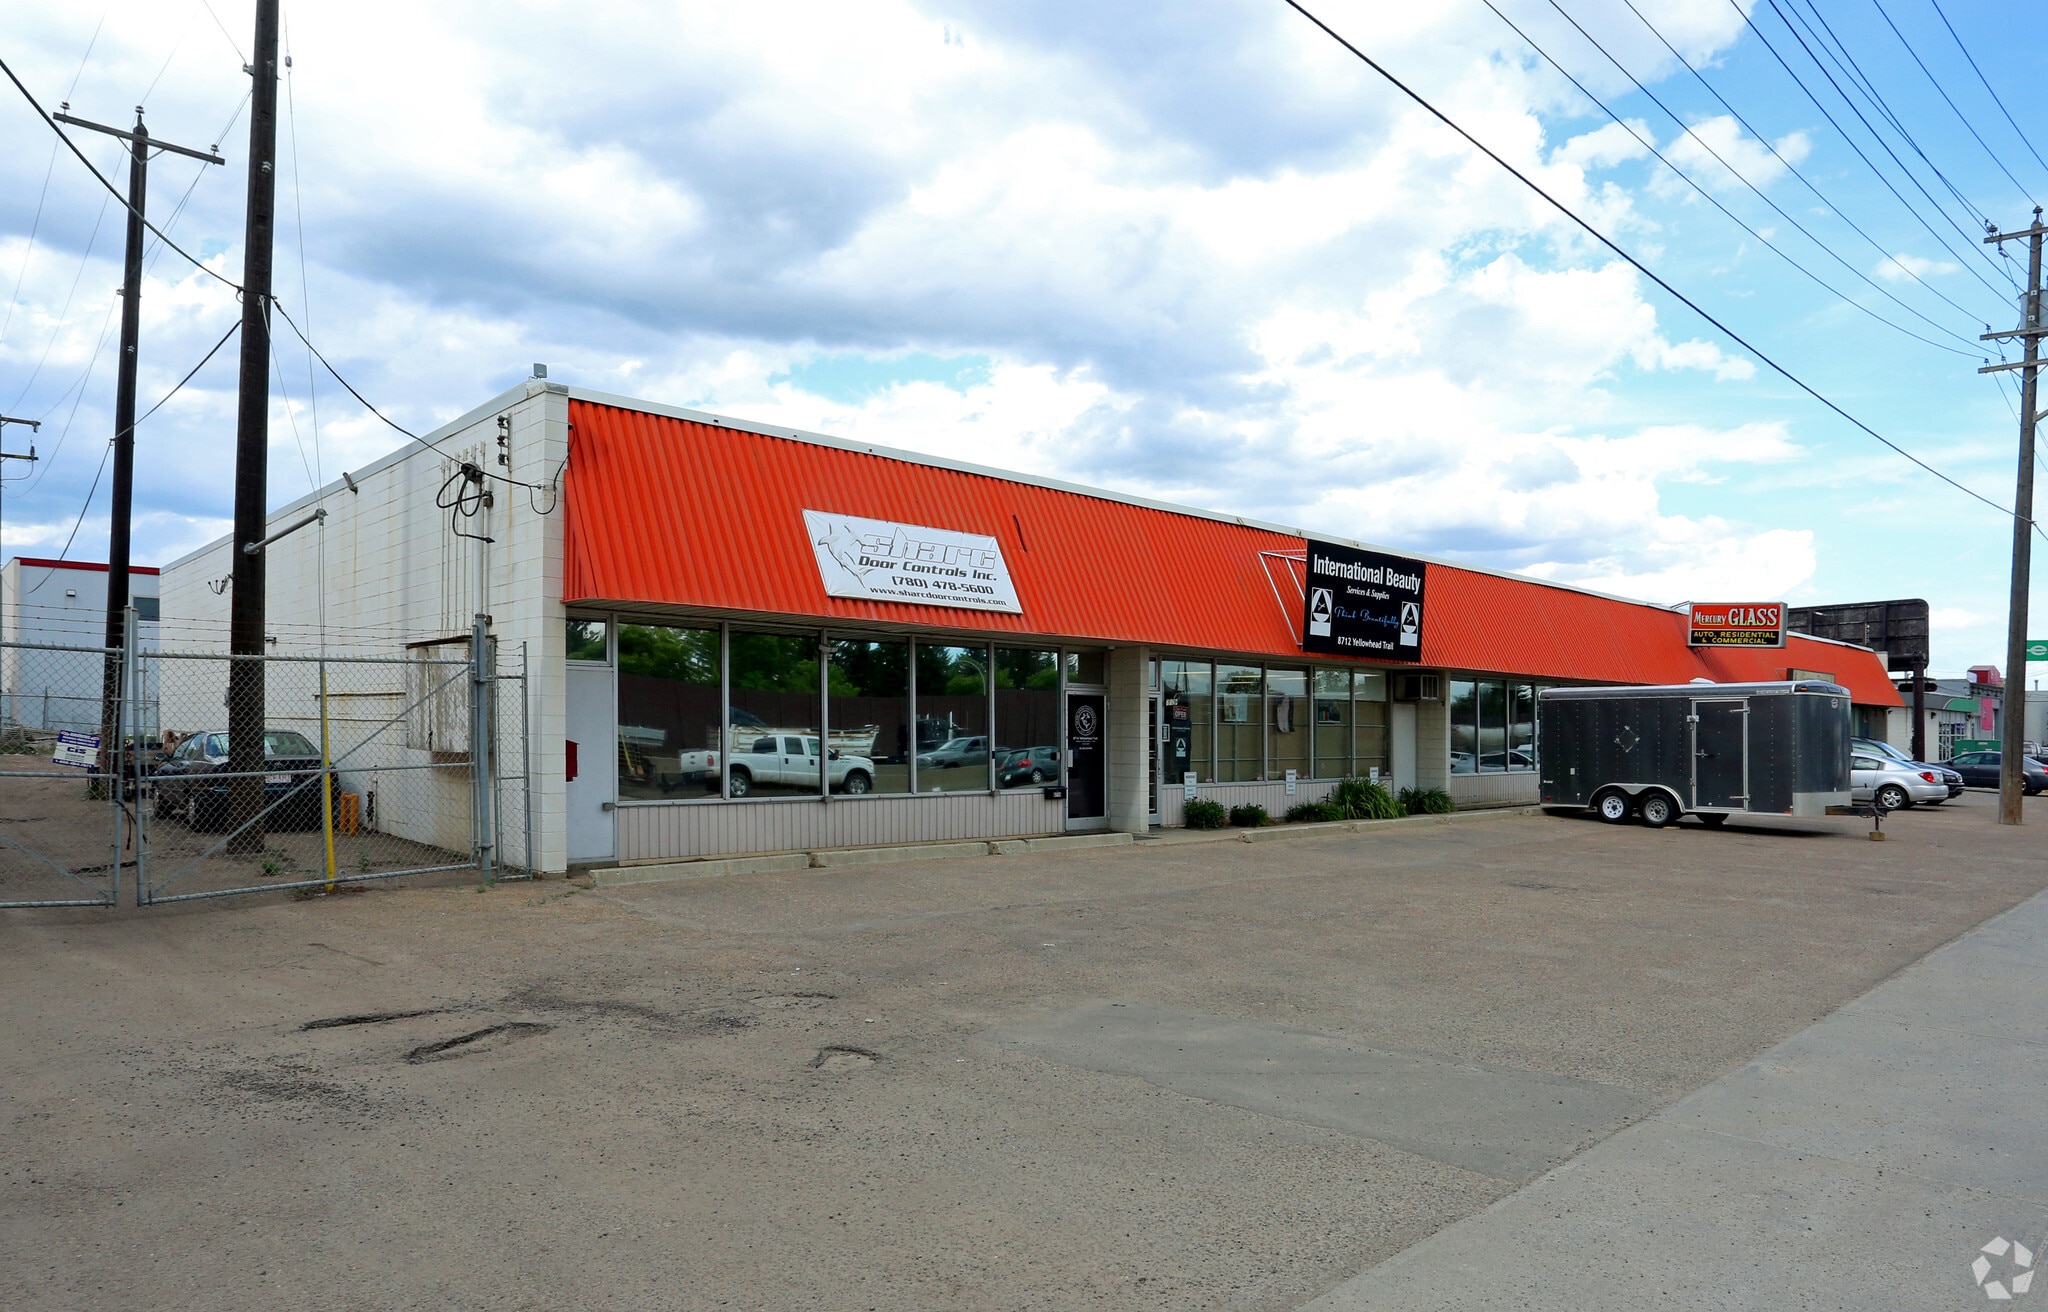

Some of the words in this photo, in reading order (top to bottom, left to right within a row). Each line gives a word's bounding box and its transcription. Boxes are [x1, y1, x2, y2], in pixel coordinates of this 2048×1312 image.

[860, 526, 997, 569] sharc
[858, 555, 898, 569] Door
[902, 561, 967, 578] Controls
[972, 569, 998, 581] Inc.
[1313, 553, 1384, 585] International
[1386, 567, 1421, 595] Beauty
[892, 576, 929, 589] (780)
[932, 581, 994, 595] 478-5600
[1346, 585, 1366, 597] Services
[1366, 588, 1371, 596] &
[1370, 589, 1390, 600] Supplies
[869, 586, 1007, 606] www.sharcdoorcontrols.com
[1334, 605, 1357, 619] Think
[1360, 608, 1399, 628] Beautifully
[1728, 607, 1778, 626] GLASS
[1337, 636, 1352, 646] 8712
[1352, 637, 1382, 649] Yellowhead
[1382, 641, 1394, 650] Trail
